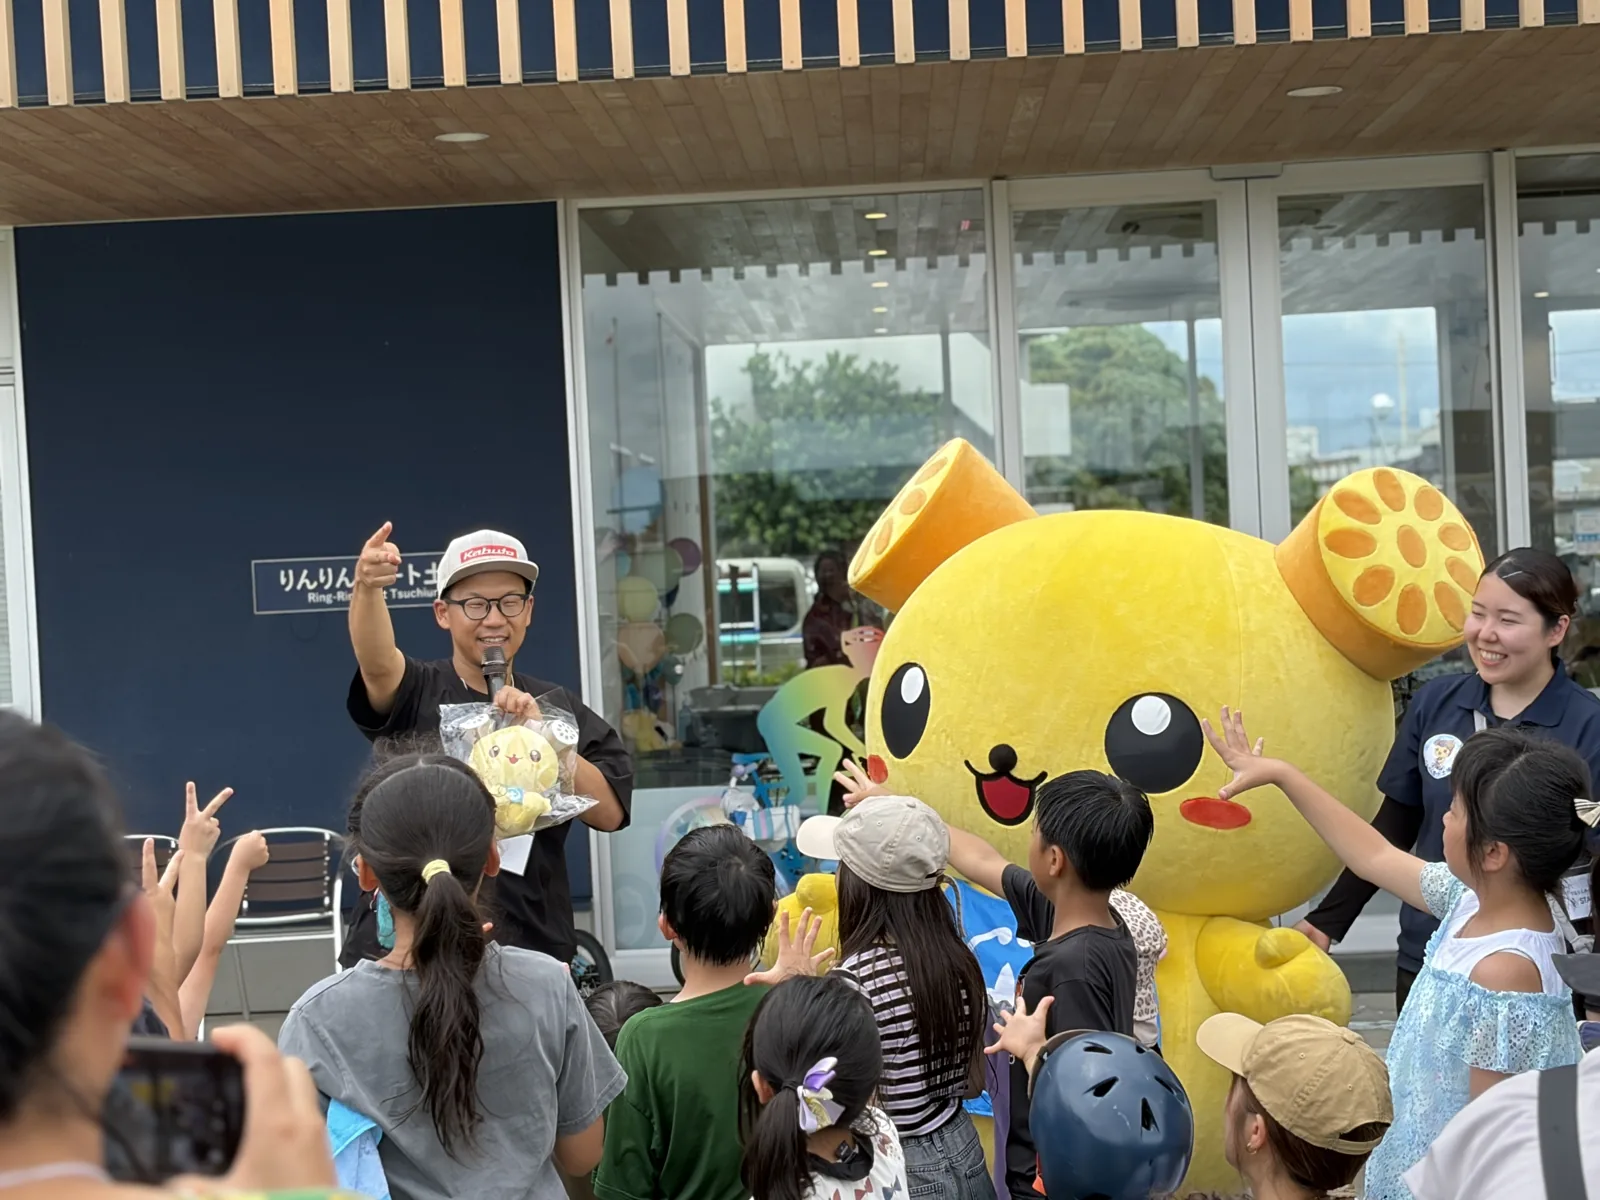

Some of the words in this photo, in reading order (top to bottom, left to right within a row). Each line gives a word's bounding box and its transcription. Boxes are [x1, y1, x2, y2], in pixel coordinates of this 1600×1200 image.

[463, 547, 515, 560] Kabuto
[307, 590, 354, 605] Ring-Rin
[389, 587, 438, 600] Tsuchiur
